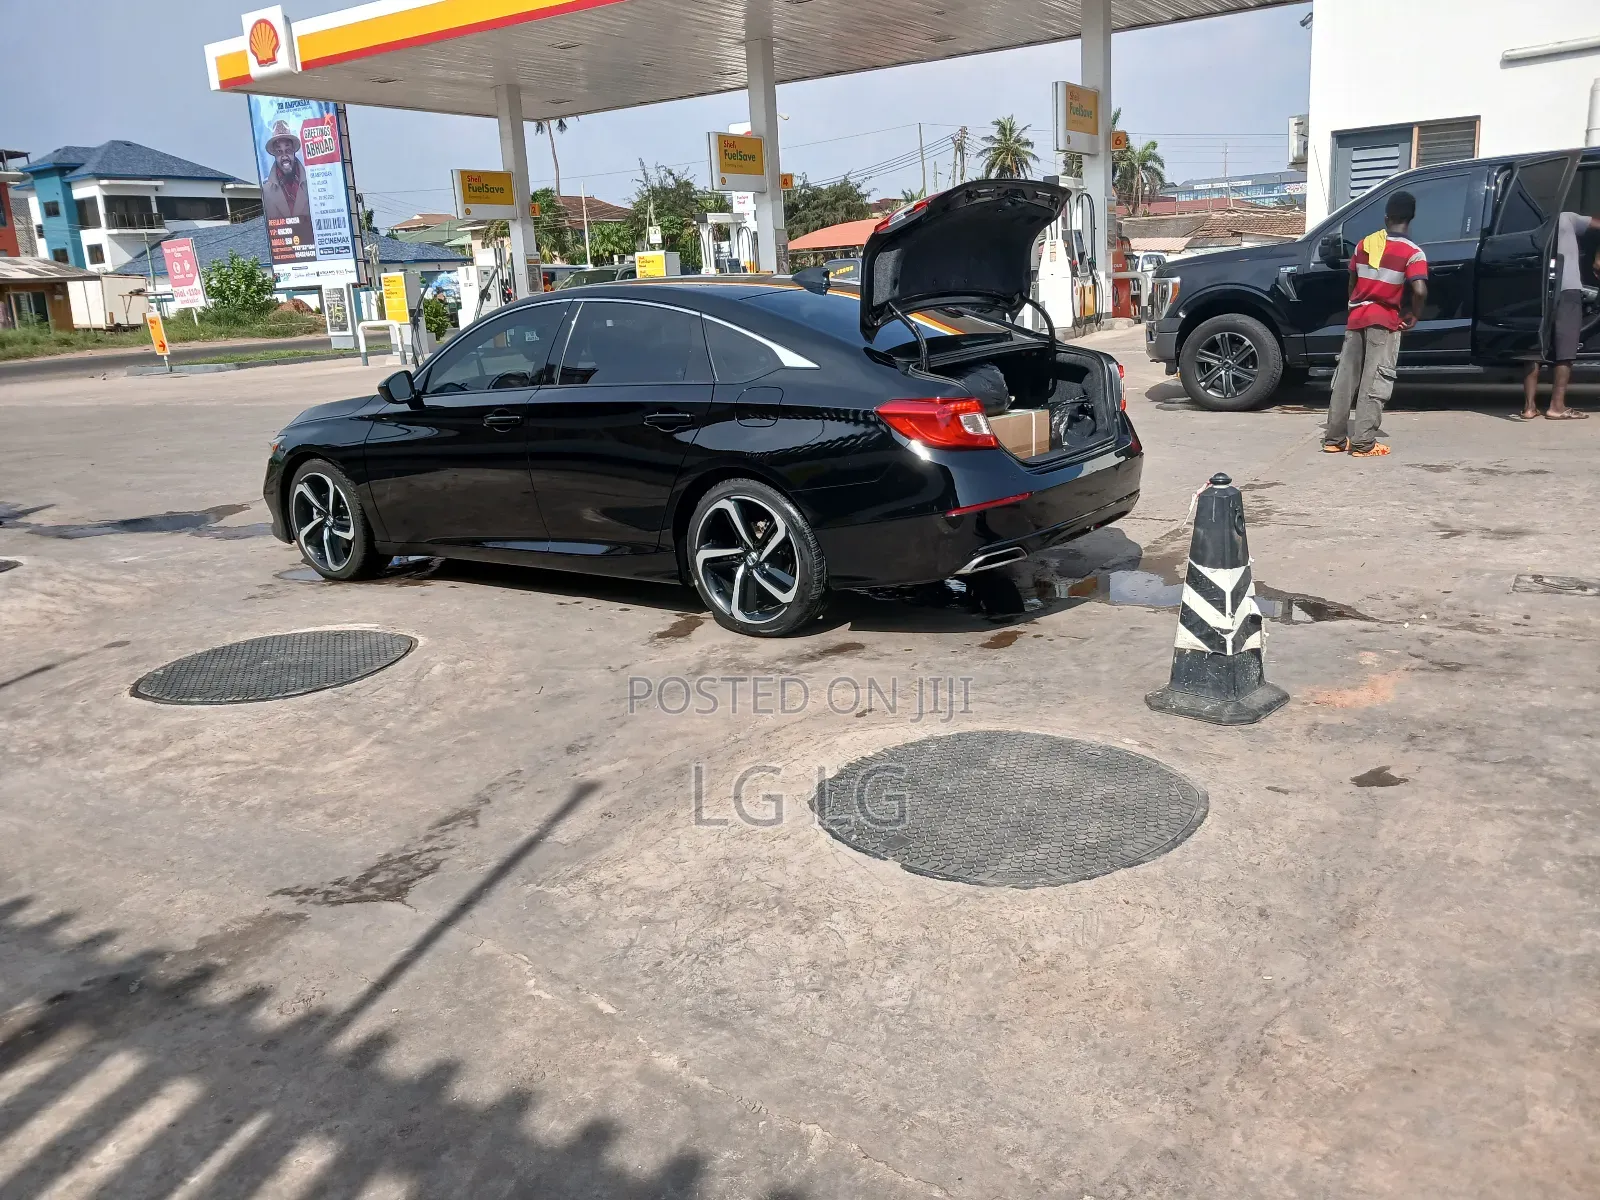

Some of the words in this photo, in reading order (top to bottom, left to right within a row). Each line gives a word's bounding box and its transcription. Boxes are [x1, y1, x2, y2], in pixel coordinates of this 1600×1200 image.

[304, 127, 330, 138] GREETINGS
[723, 140, 736, 150] Shell
[1115, 136, 1122, 146] 6
[306, 138, 334, 158] ABROAD
[724, 149, 756, 162] FuelSave
[468, 184, 504, 194] FuelSave
